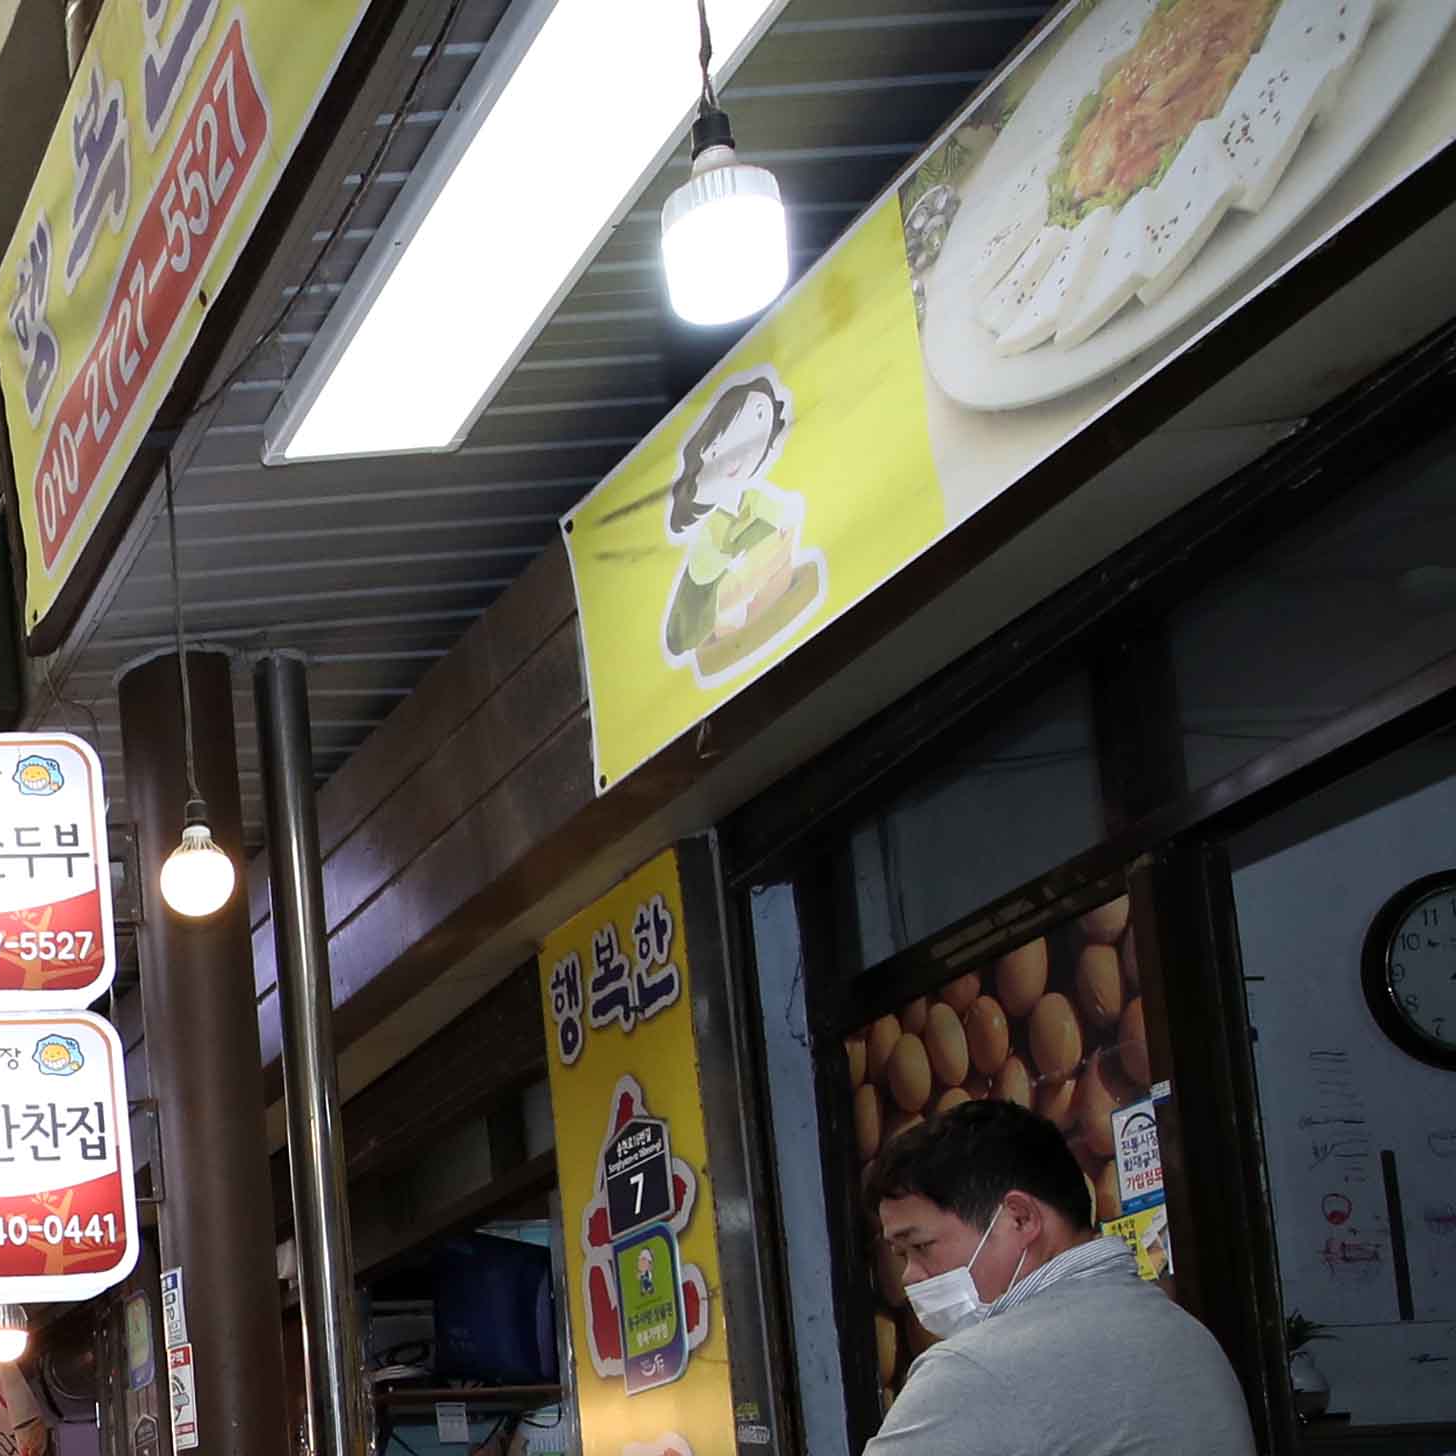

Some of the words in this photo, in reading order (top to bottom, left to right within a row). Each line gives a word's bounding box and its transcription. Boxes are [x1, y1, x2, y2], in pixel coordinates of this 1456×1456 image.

[41, 50, 248, 546] 010-2727-5527
[550, 891, 681, 1064] 행복한
[629, 1172, 645, 1216] 7
